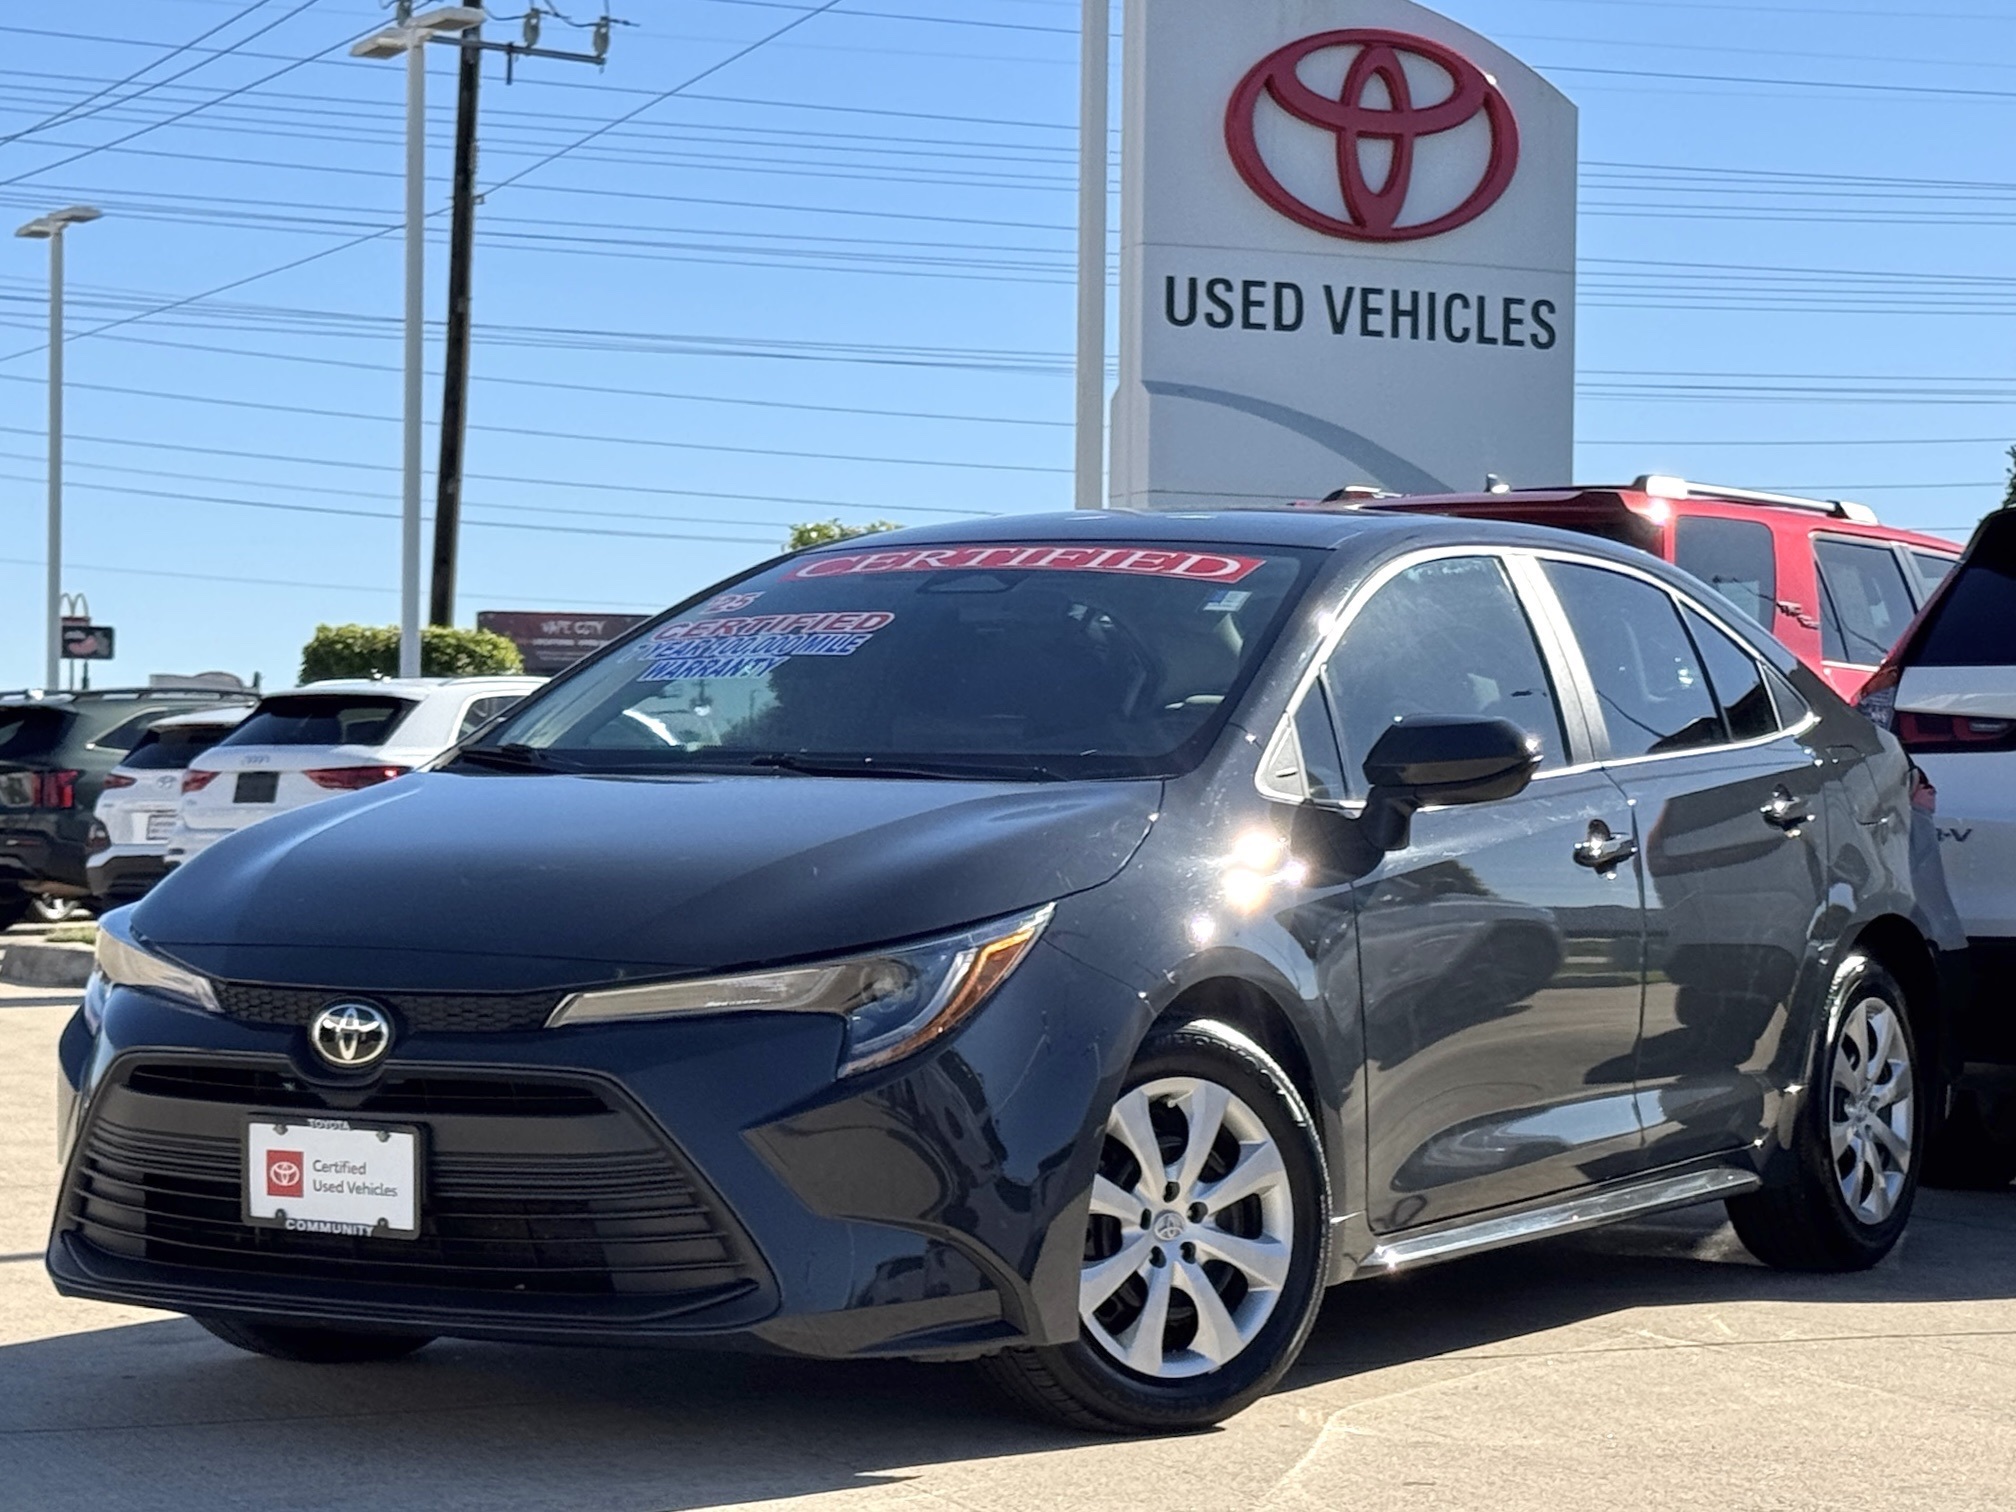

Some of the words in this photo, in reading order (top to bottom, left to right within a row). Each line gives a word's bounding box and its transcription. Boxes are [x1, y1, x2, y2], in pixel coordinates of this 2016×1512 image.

[1165, 275, 1304, 332] USED
[1322, 284, 1557, 350] VEHICLES
[794, 547, 1241, 579] CERTIFIED
[653, 613, 893, 641] CERTIFIED
[793, 634, 871, 654] MILE
[640, 656, 787, 680] WARRANTY
[307, 1118, 350, 1130] TOYOTA
[312, 1159, 367, 1175] Certified
[312, 1178, 344, 1194] Used
[347, 1180, 398, 1197] Vehicles
[285, 1219, 374, 1238] COMMUNITY
